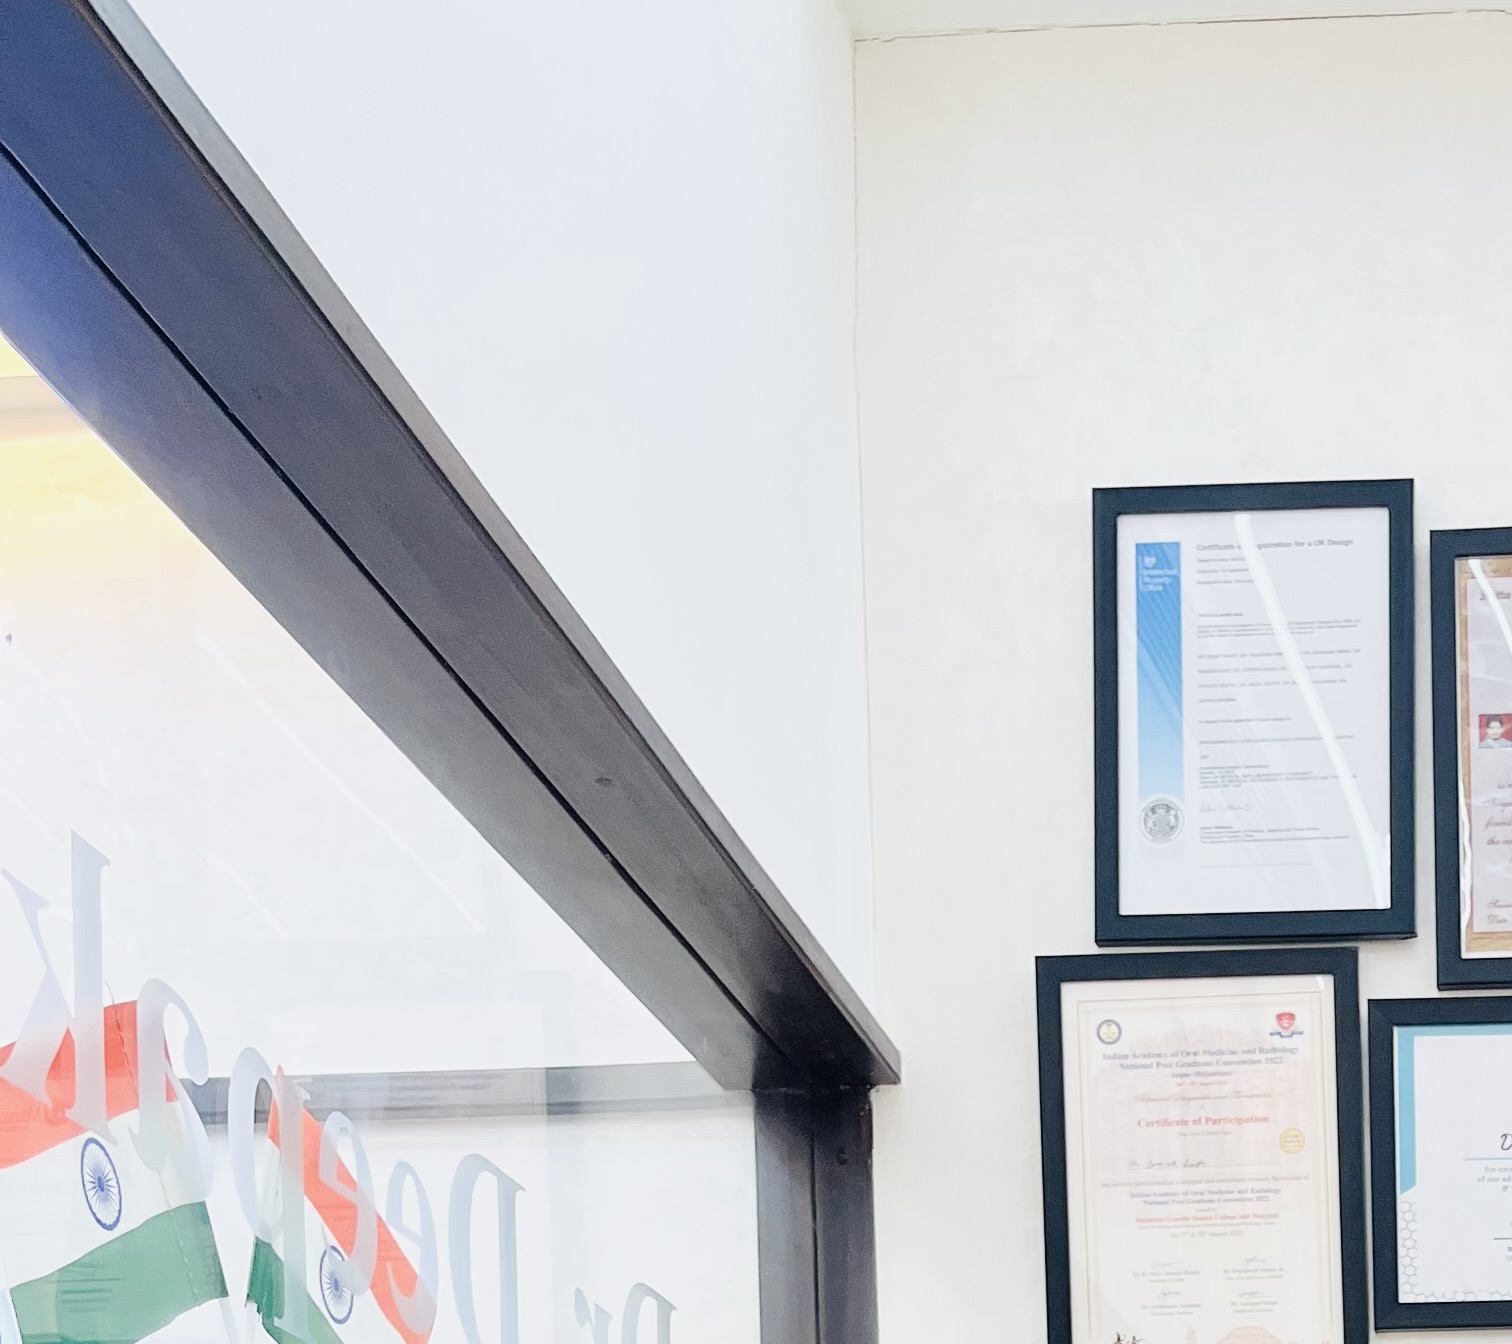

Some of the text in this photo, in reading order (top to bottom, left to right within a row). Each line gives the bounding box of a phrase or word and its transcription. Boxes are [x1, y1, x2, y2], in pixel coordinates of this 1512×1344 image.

[1138, 1116, 1269, 1128] Certificate of Participation
